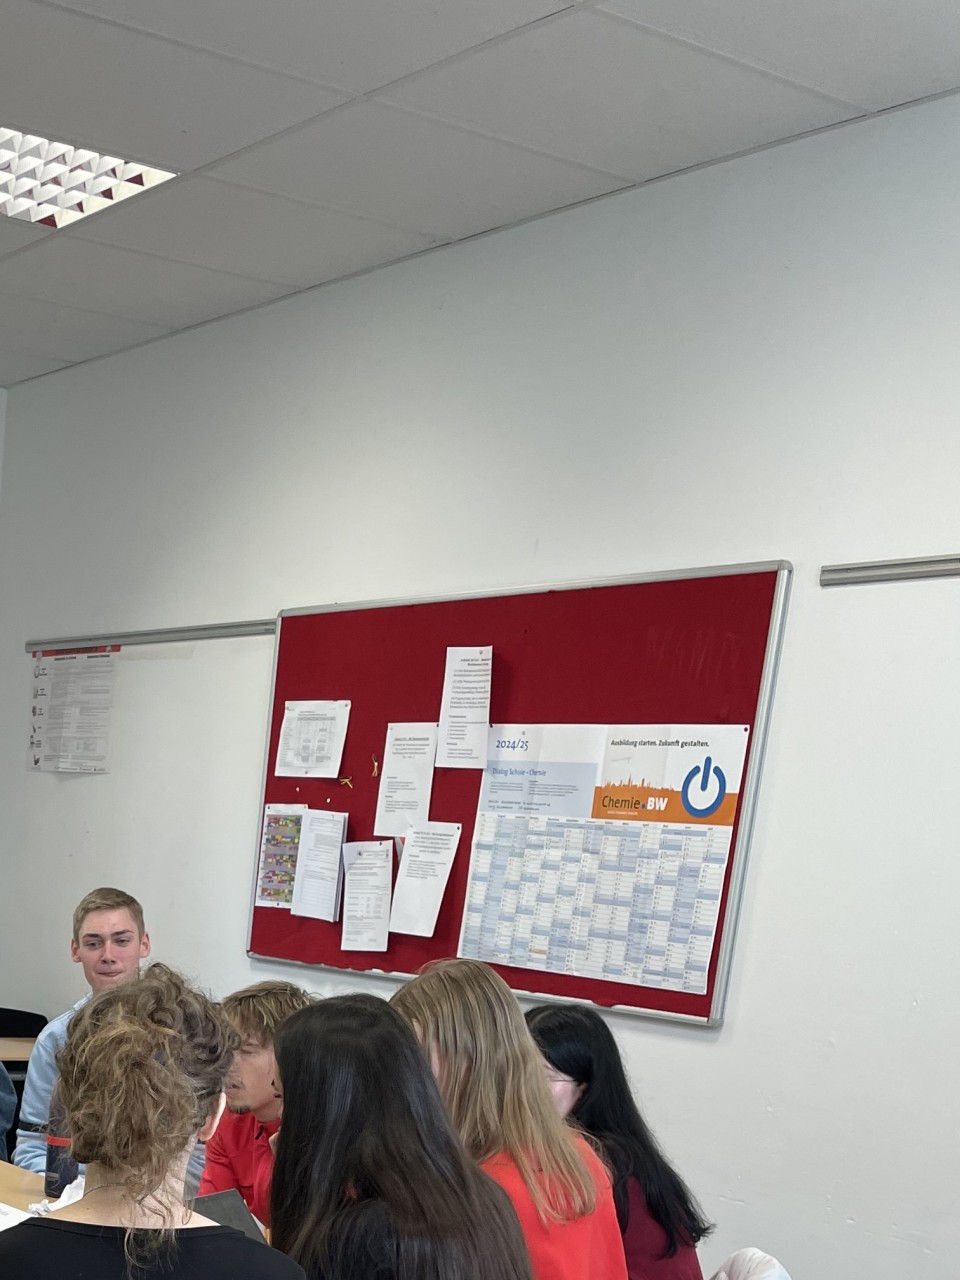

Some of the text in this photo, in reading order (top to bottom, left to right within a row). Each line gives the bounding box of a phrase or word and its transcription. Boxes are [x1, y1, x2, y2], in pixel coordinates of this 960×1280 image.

[496, 739, 529, 751] 2024/25
[611, 739, 637, 748] Ausbildung
[658, 739, 680, 747] Zukunft
[680, 740, 709, 748] gestalten.
